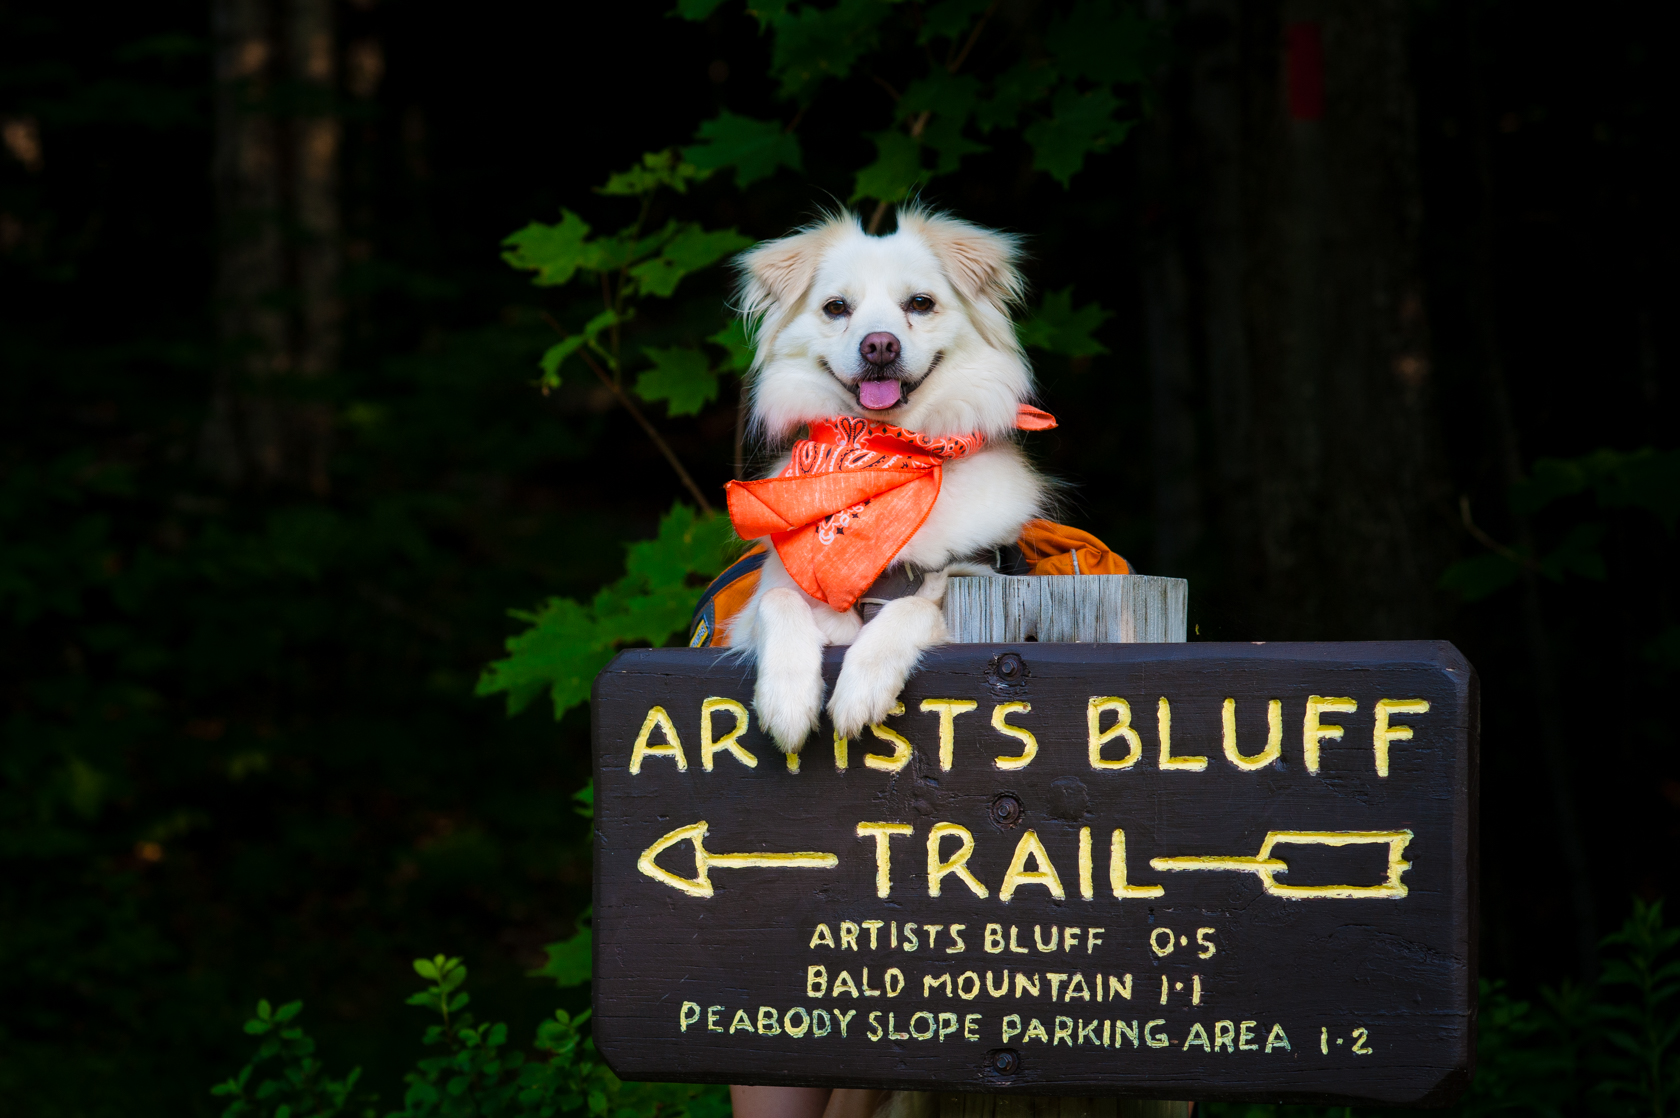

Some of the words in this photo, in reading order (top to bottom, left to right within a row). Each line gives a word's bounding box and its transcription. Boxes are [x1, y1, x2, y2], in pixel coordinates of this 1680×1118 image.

[629, 696, 1038, 774] ARISTS
[1087, 695, 1431, 776] BLUFF
[855, 820, 1165, 902] TRAIL
[808, 919, 967, 955] ARTISTS
[983, 922, 1106, 955] BLUFF
[806, 964, 906, 999] BALD
[922, 968, 1133, 1003] MOUNTAIN
[679, 1000, 857, 1039] PEABODY
[866, 1010, 983, 1043] SLOPE
[1001, 1013, 1170, 1049] PARKING
[1181, 1019, 1291, 1054] AREA
